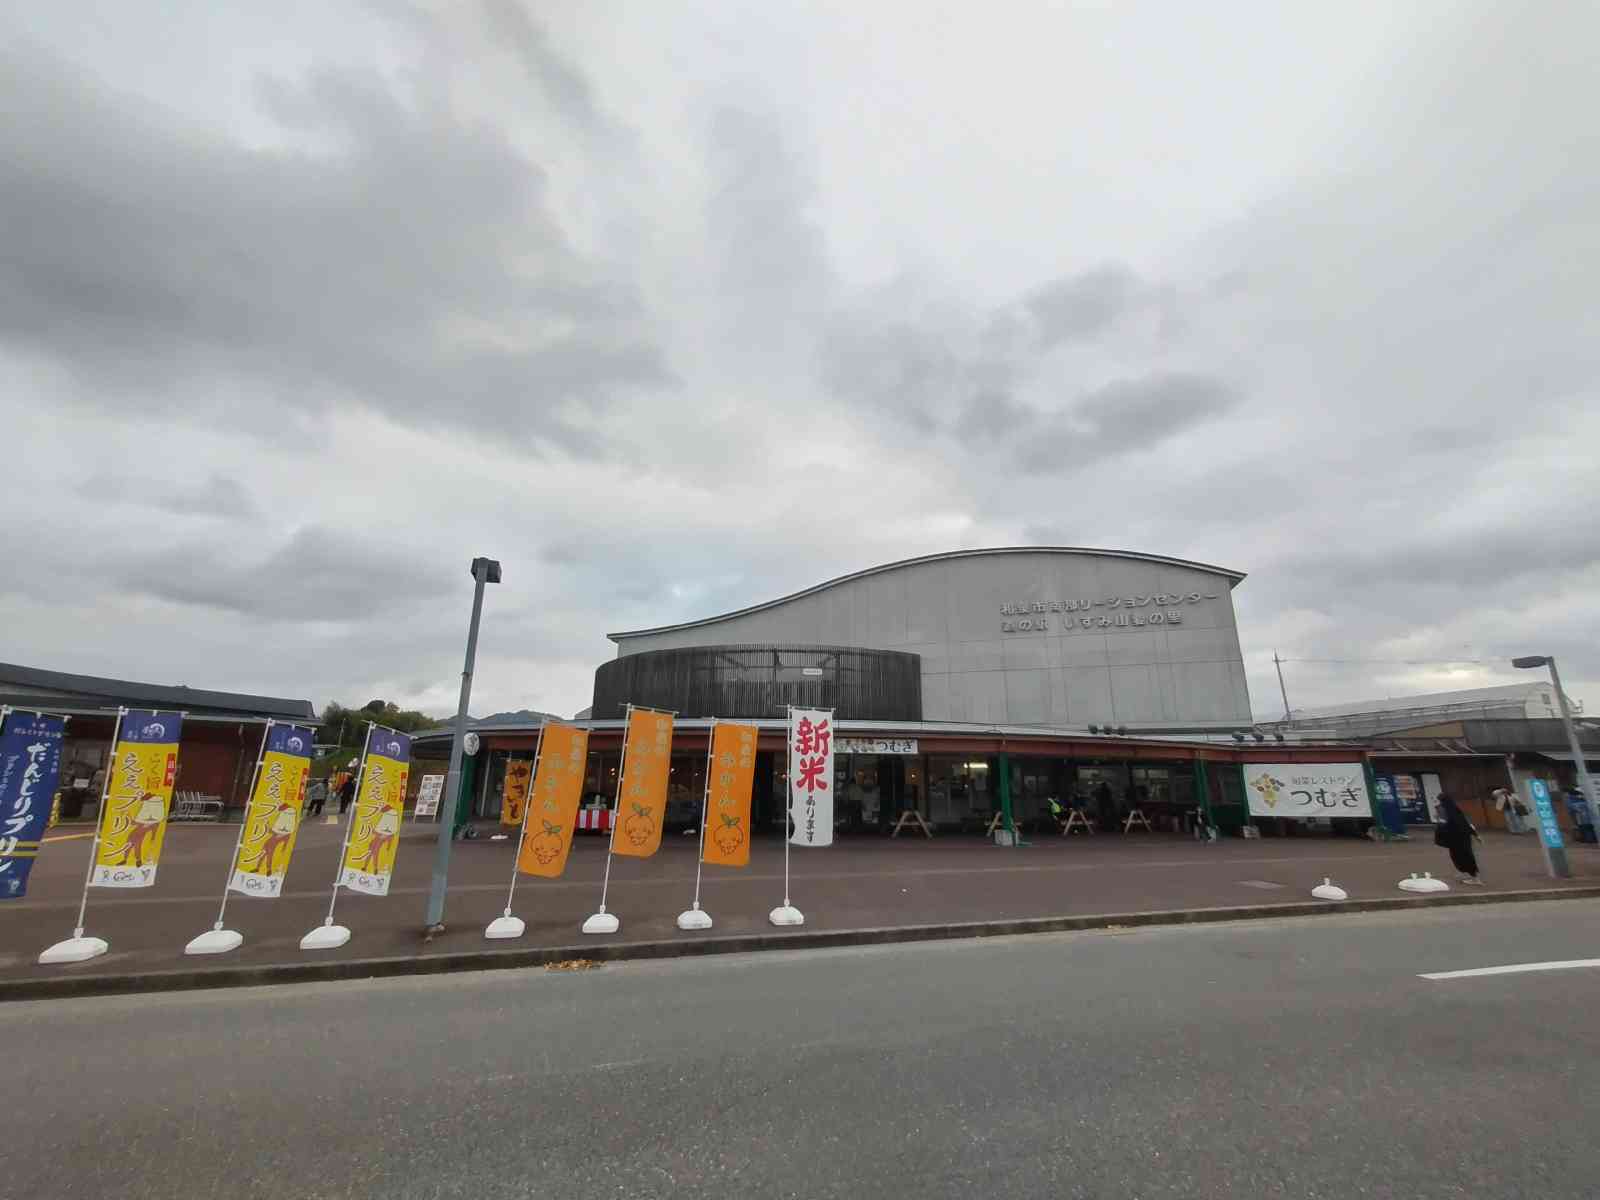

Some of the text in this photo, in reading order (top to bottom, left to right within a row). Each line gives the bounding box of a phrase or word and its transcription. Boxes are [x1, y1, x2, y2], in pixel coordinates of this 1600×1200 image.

[795, 716, 830, 793] 新米
[879, 740, 912, 753] つむぎ
[1290, 787, 1362, 808] つむぎ
[805, 795, 816, 843] あります
